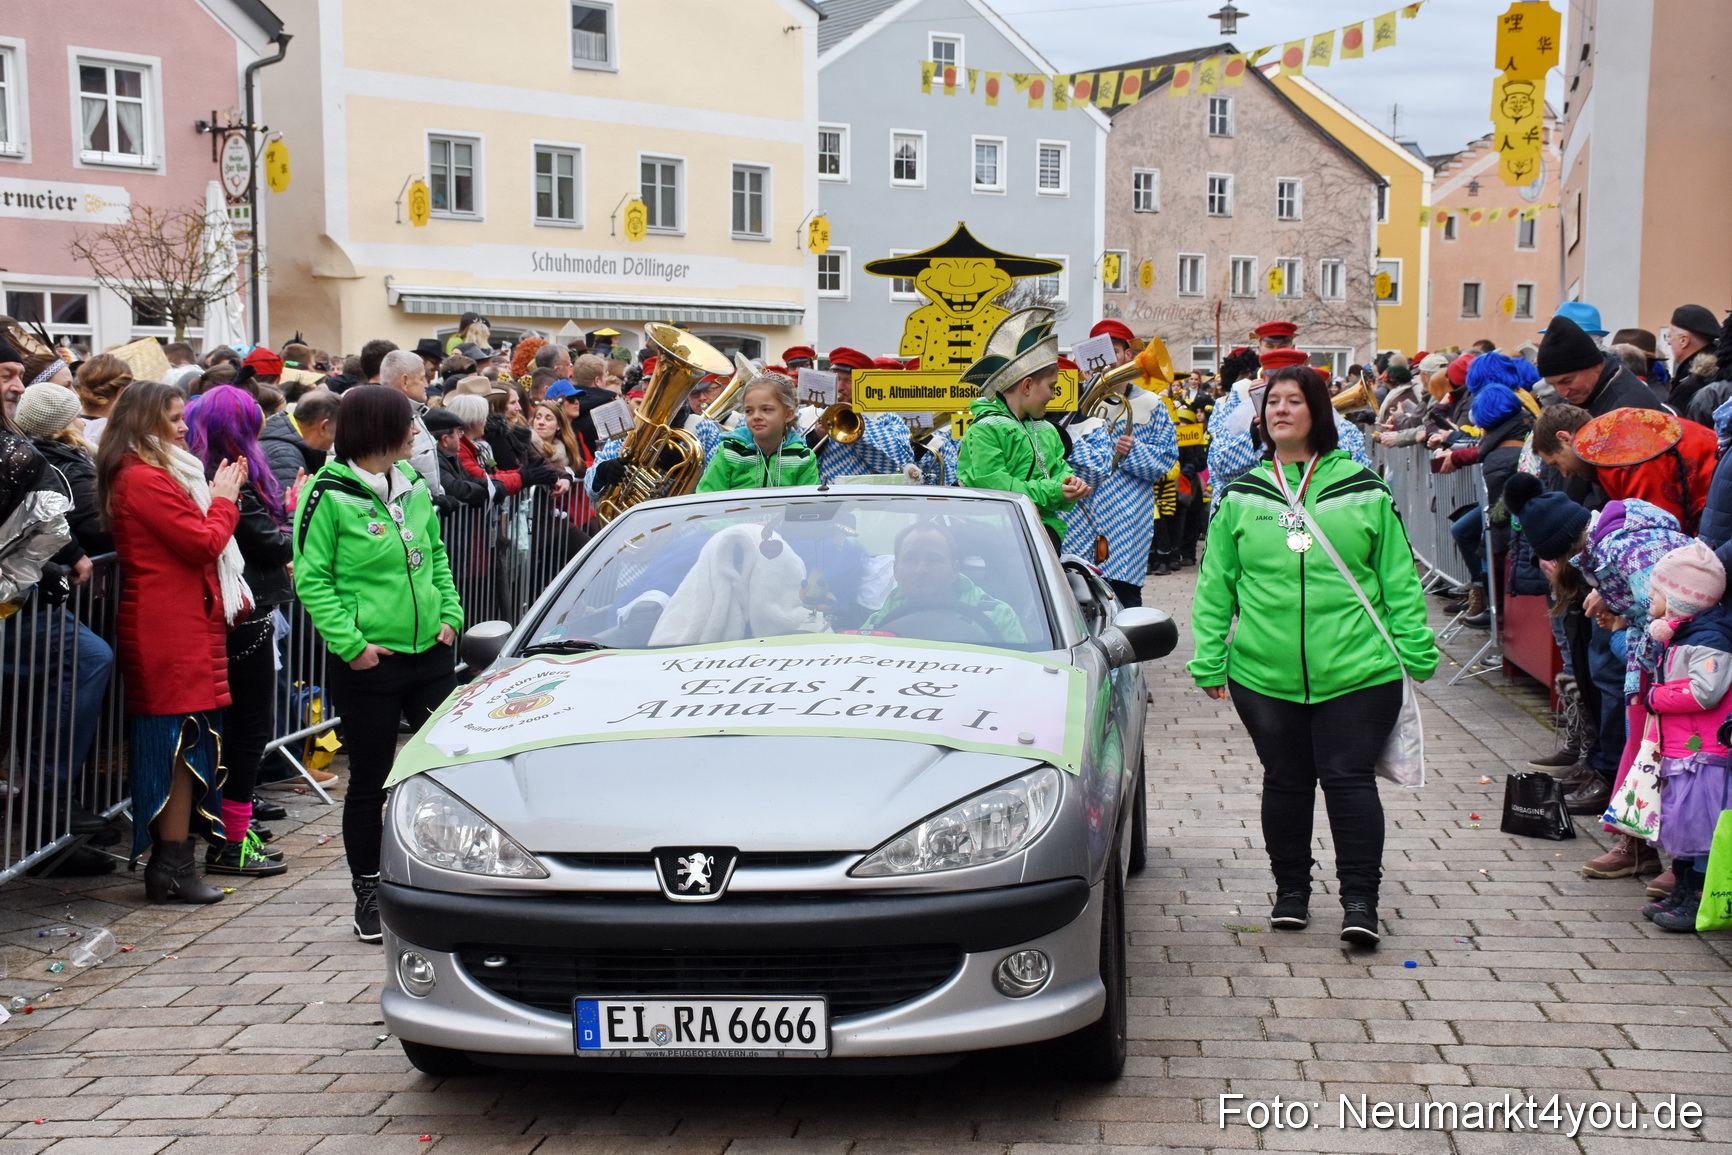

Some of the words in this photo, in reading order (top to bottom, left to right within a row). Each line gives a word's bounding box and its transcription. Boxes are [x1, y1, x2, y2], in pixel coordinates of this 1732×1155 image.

[1537, 37, 1552, 54] 华
[1505, 57, 1518, 71] 人
[1500, 135, 1514, 152] 人
[0, 189, 77, 211] rmeier
[532, 251, 617, 275] Schuhmoden
[623, 257, 690, 282] Döllinger
[865, 385, 886, 400] Org.
[889, 385, 947, 398] Altmühltaler
[950, 386, 984, 398] Blaska
[1176, 431, 1199, 441] chule
[660, 653, 1003, 676] Kinderprinzenpaar
[680, 676, 828, 696] Elias
[840, 676, 875, 694] I.
[898, 681, 958, 698] &
[519, 714, 549, 725] 2000
[553, 706, 575, 715] e.V.
[607, 697, 944, 724] Anna-Lena
[963, 709, 999, 731] I.
[584, 1029, 593, 1041] D
[607, 1006, 649, 1042] EI
[674, 1006, 719, 1042] RA
[728, 1007, 816, 1043] 6666
[645, 1050, 759, 1058] www.PEUGEOT-BAYERN.de
